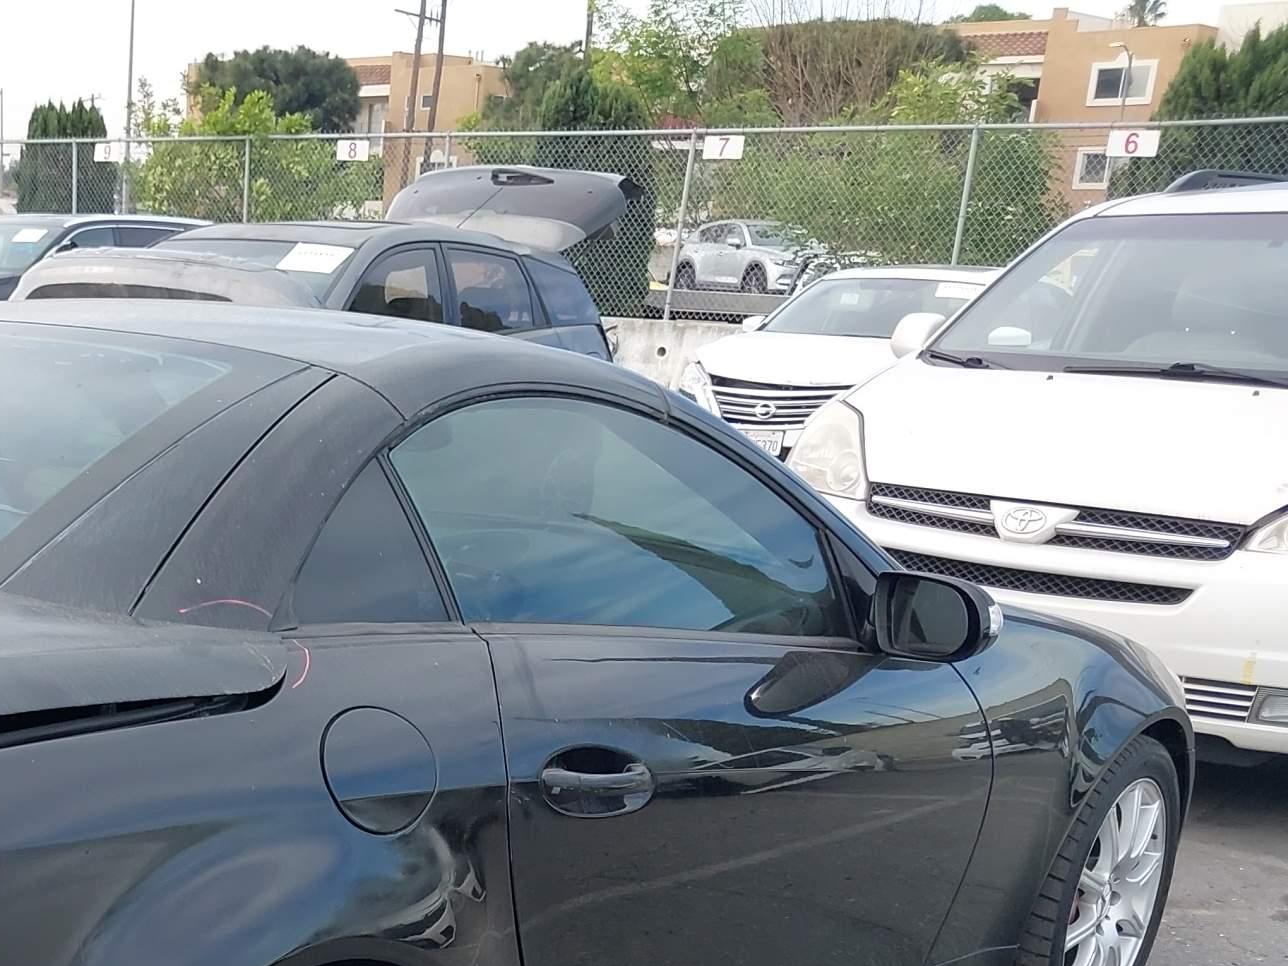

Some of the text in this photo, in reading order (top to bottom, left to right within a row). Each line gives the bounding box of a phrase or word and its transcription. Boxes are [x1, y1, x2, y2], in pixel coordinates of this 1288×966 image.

[104, 144, 111, 160] 9
[348, 142, 357, 159] 8
[719, 137, 730, 157] 7
[1124, 132, 1139, 154] 6
